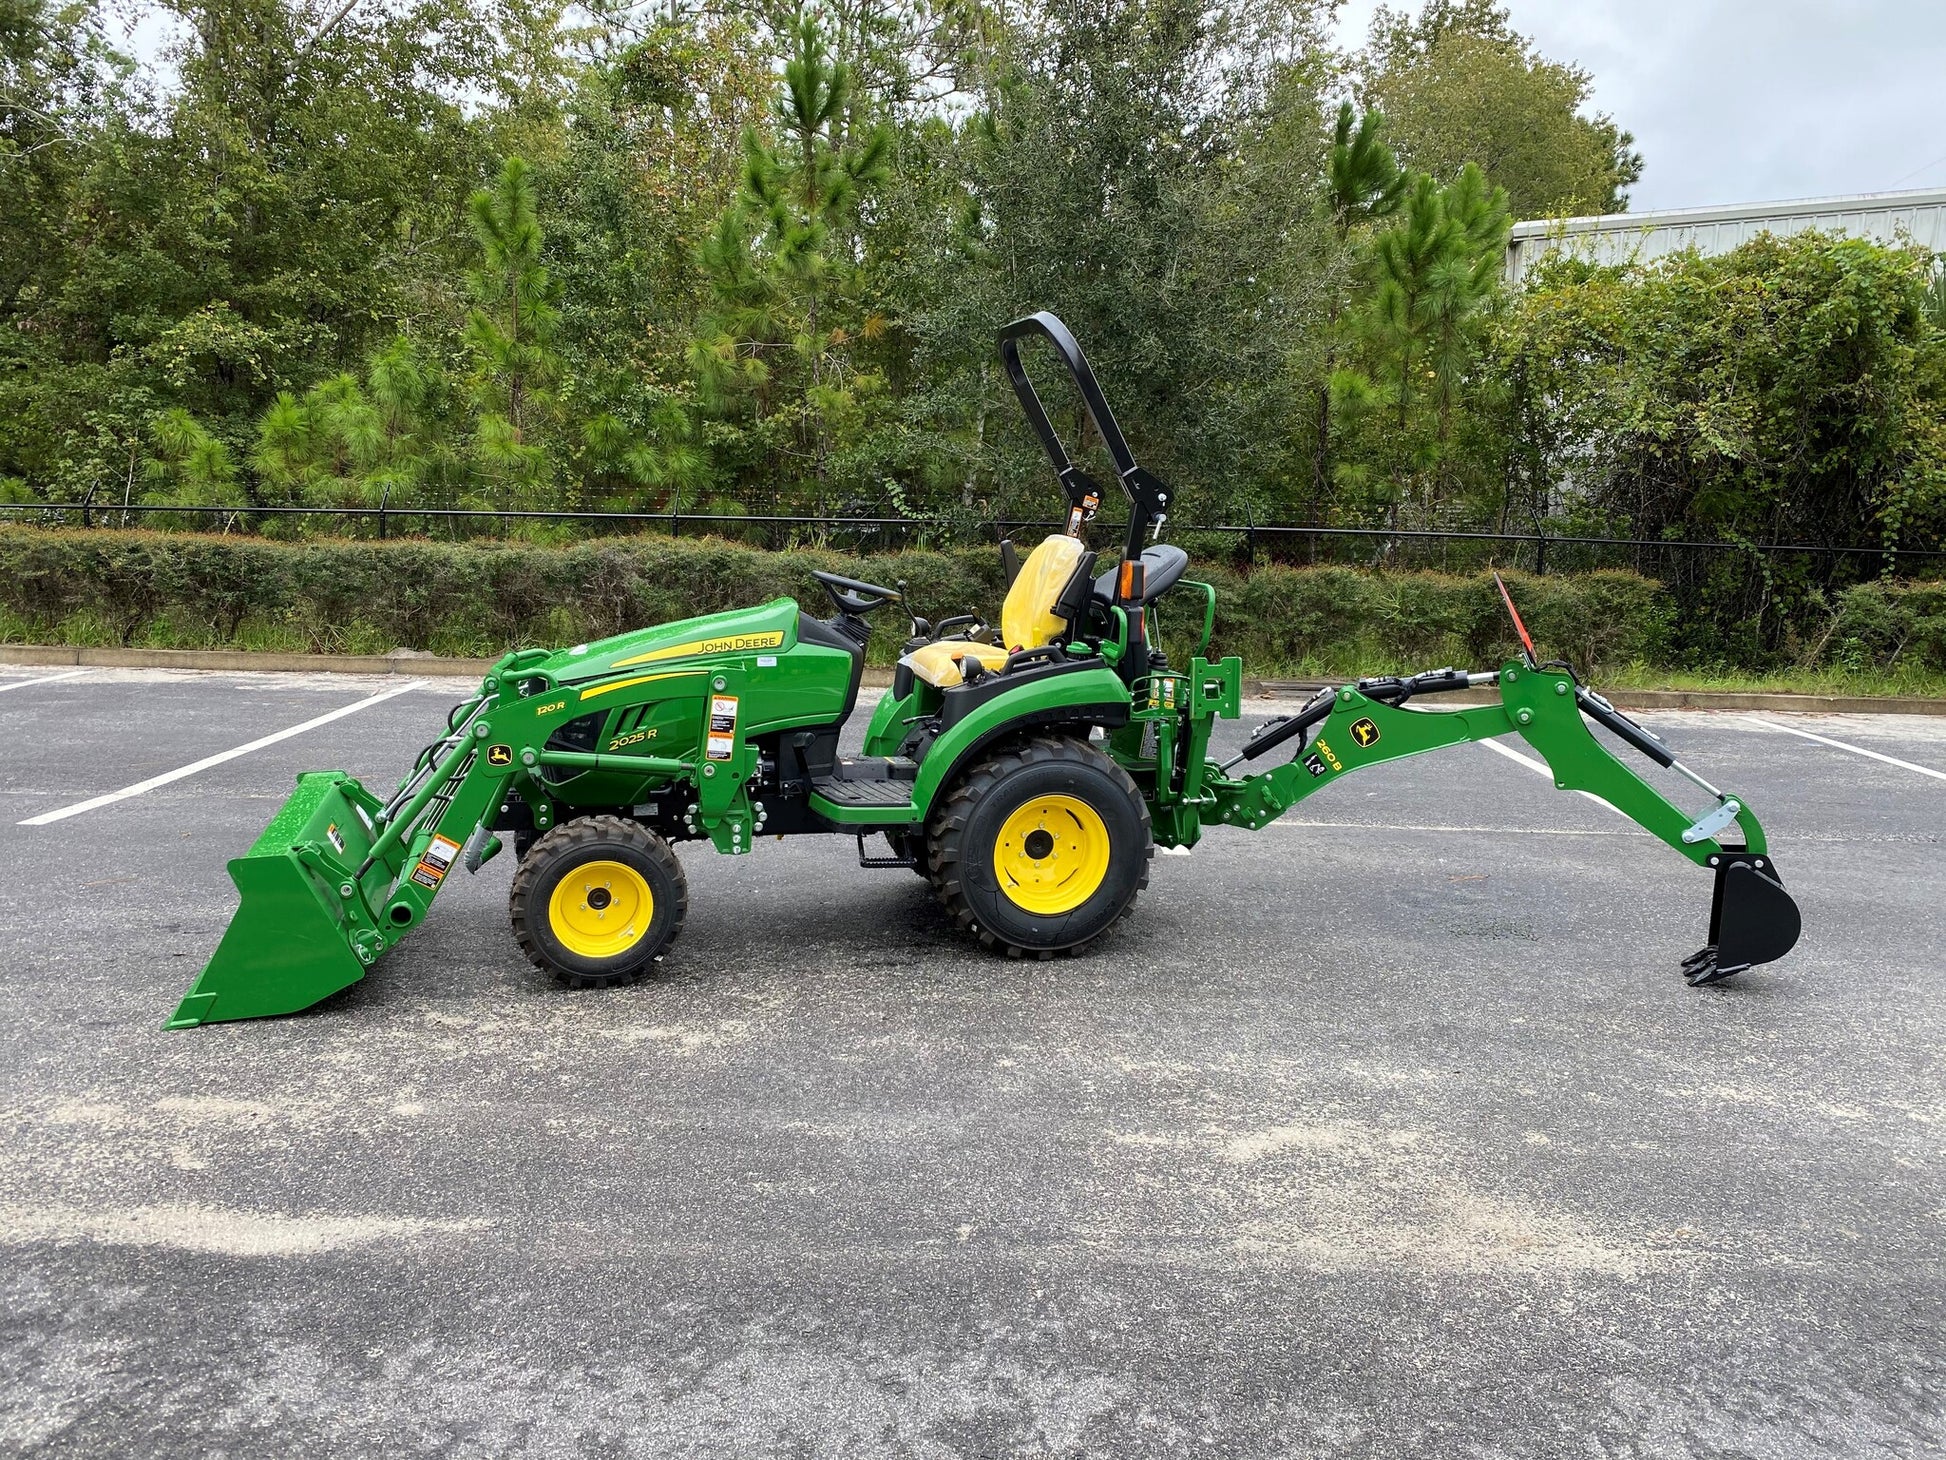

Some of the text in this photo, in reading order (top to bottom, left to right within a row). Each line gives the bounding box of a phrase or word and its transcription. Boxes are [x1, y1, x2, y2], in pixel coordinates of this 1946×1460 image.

[697, 637, 777, 654] JOHN DEERE
[536, 701, 565, 716] 120 R
[608, 728, 658, 752] 2025 R
[1316, 738, 1343, 771] 260 B
